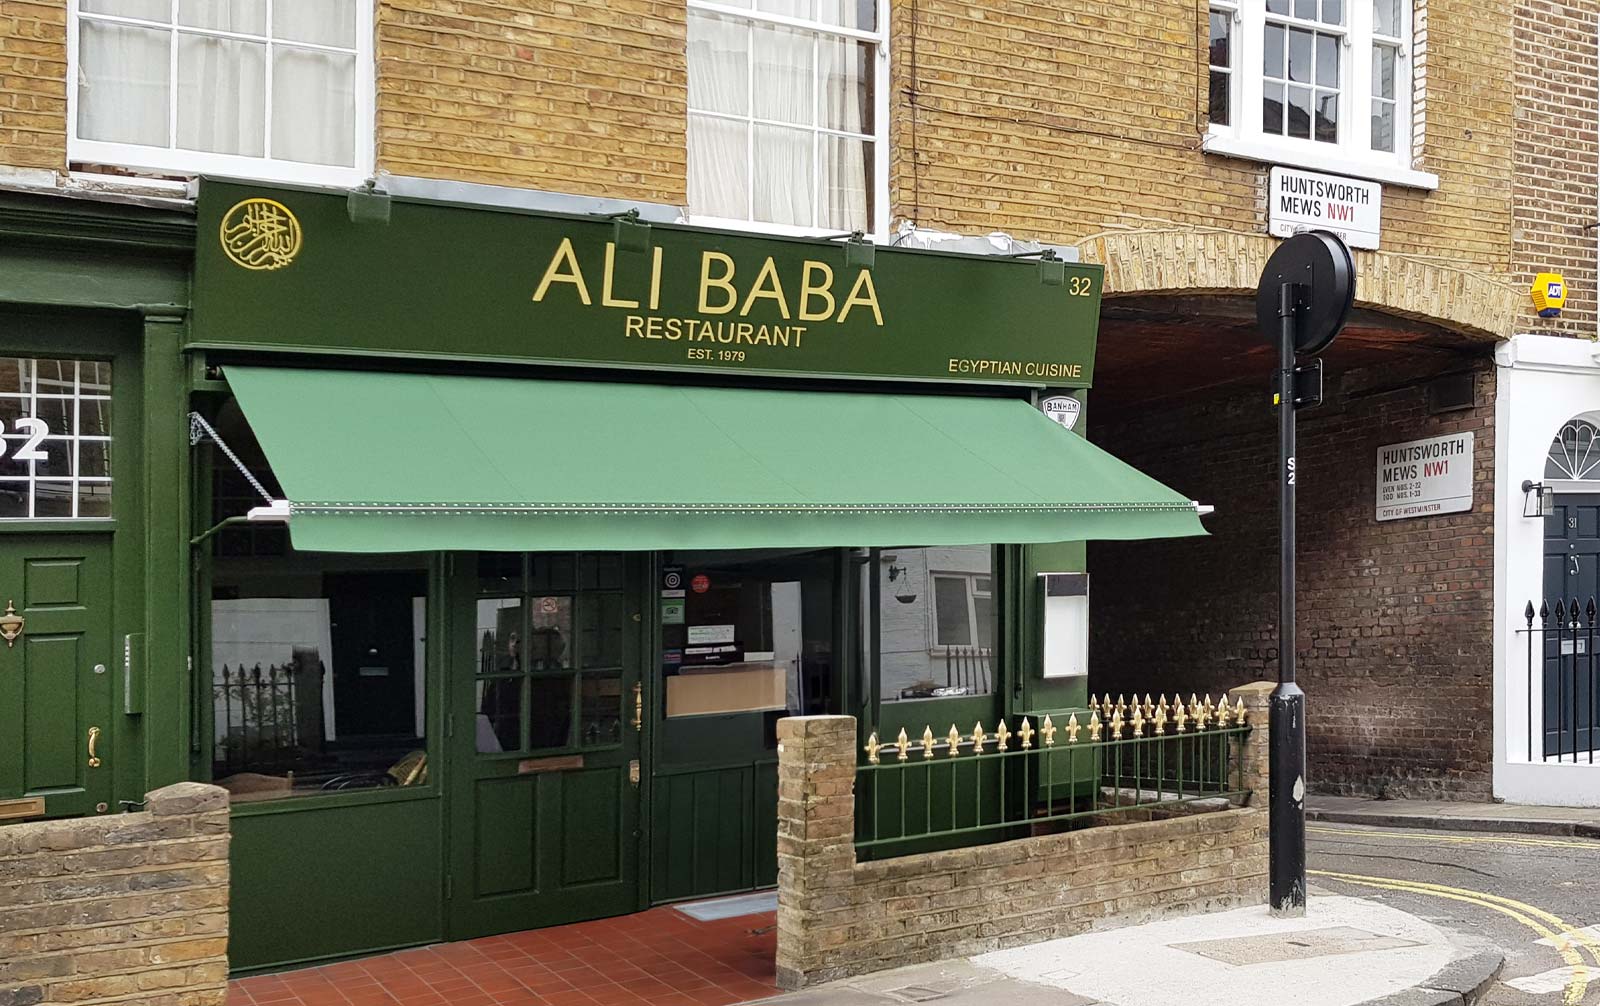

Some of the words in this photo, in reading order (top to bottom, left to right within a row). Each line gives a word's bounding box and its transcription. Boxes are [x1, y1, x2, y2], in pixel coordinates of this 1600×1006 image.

[1281, 175, 1369, 205] HUNTSWORTH
[1280, 195, 1321, 217] MEWS
[1327, 202, 1354, 222] NW1
[532, 237, 663, 310] ALI
[698, 251, 884, 326] BABA
[1069, 276, 1092, 297] 32
[625, 315, 807, 348] RESTAURANT
[687, 348, 714, 361] EST.
[717, 349, 746, 362] 1979
[948, 358, 1022, 375] EGYPTIAN
[1025, 362, 1082, 378] CUISINE
[1047, 402, 1077, 411] BANHAM
[1383, 439, 1464, 466] HUNTSWORTH
[1382, 464, 1417, 483] MEWS
[1424, 460, 1449, 477] NW1
[1382, 509, 1394, 517] CITY
[1403, 503, 1441, 514] WESTMINSTER
[1568, 517, 1577, 529] 31
